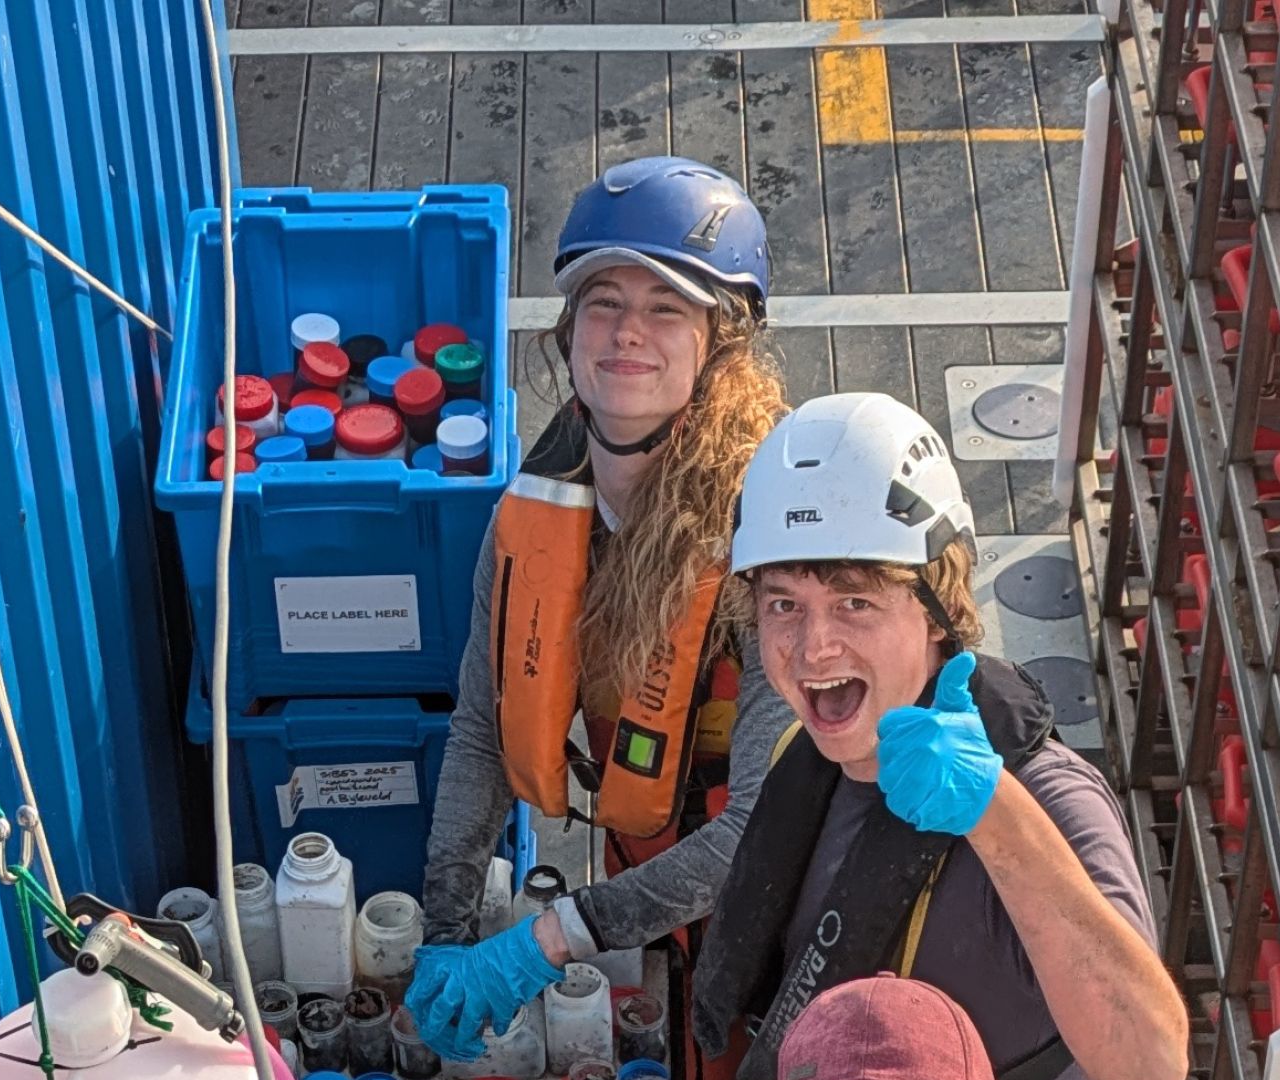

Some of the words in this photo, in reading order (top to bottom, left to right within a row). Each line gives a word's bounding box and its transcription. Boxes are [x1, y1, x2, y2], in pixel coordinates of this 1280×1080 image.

[786, 509, 823, 529] PETZL
[287, 610, 328, 620] PLACE
[332, 609, 372, 619] LABEL
[375, 608, 409, 618] HERE
